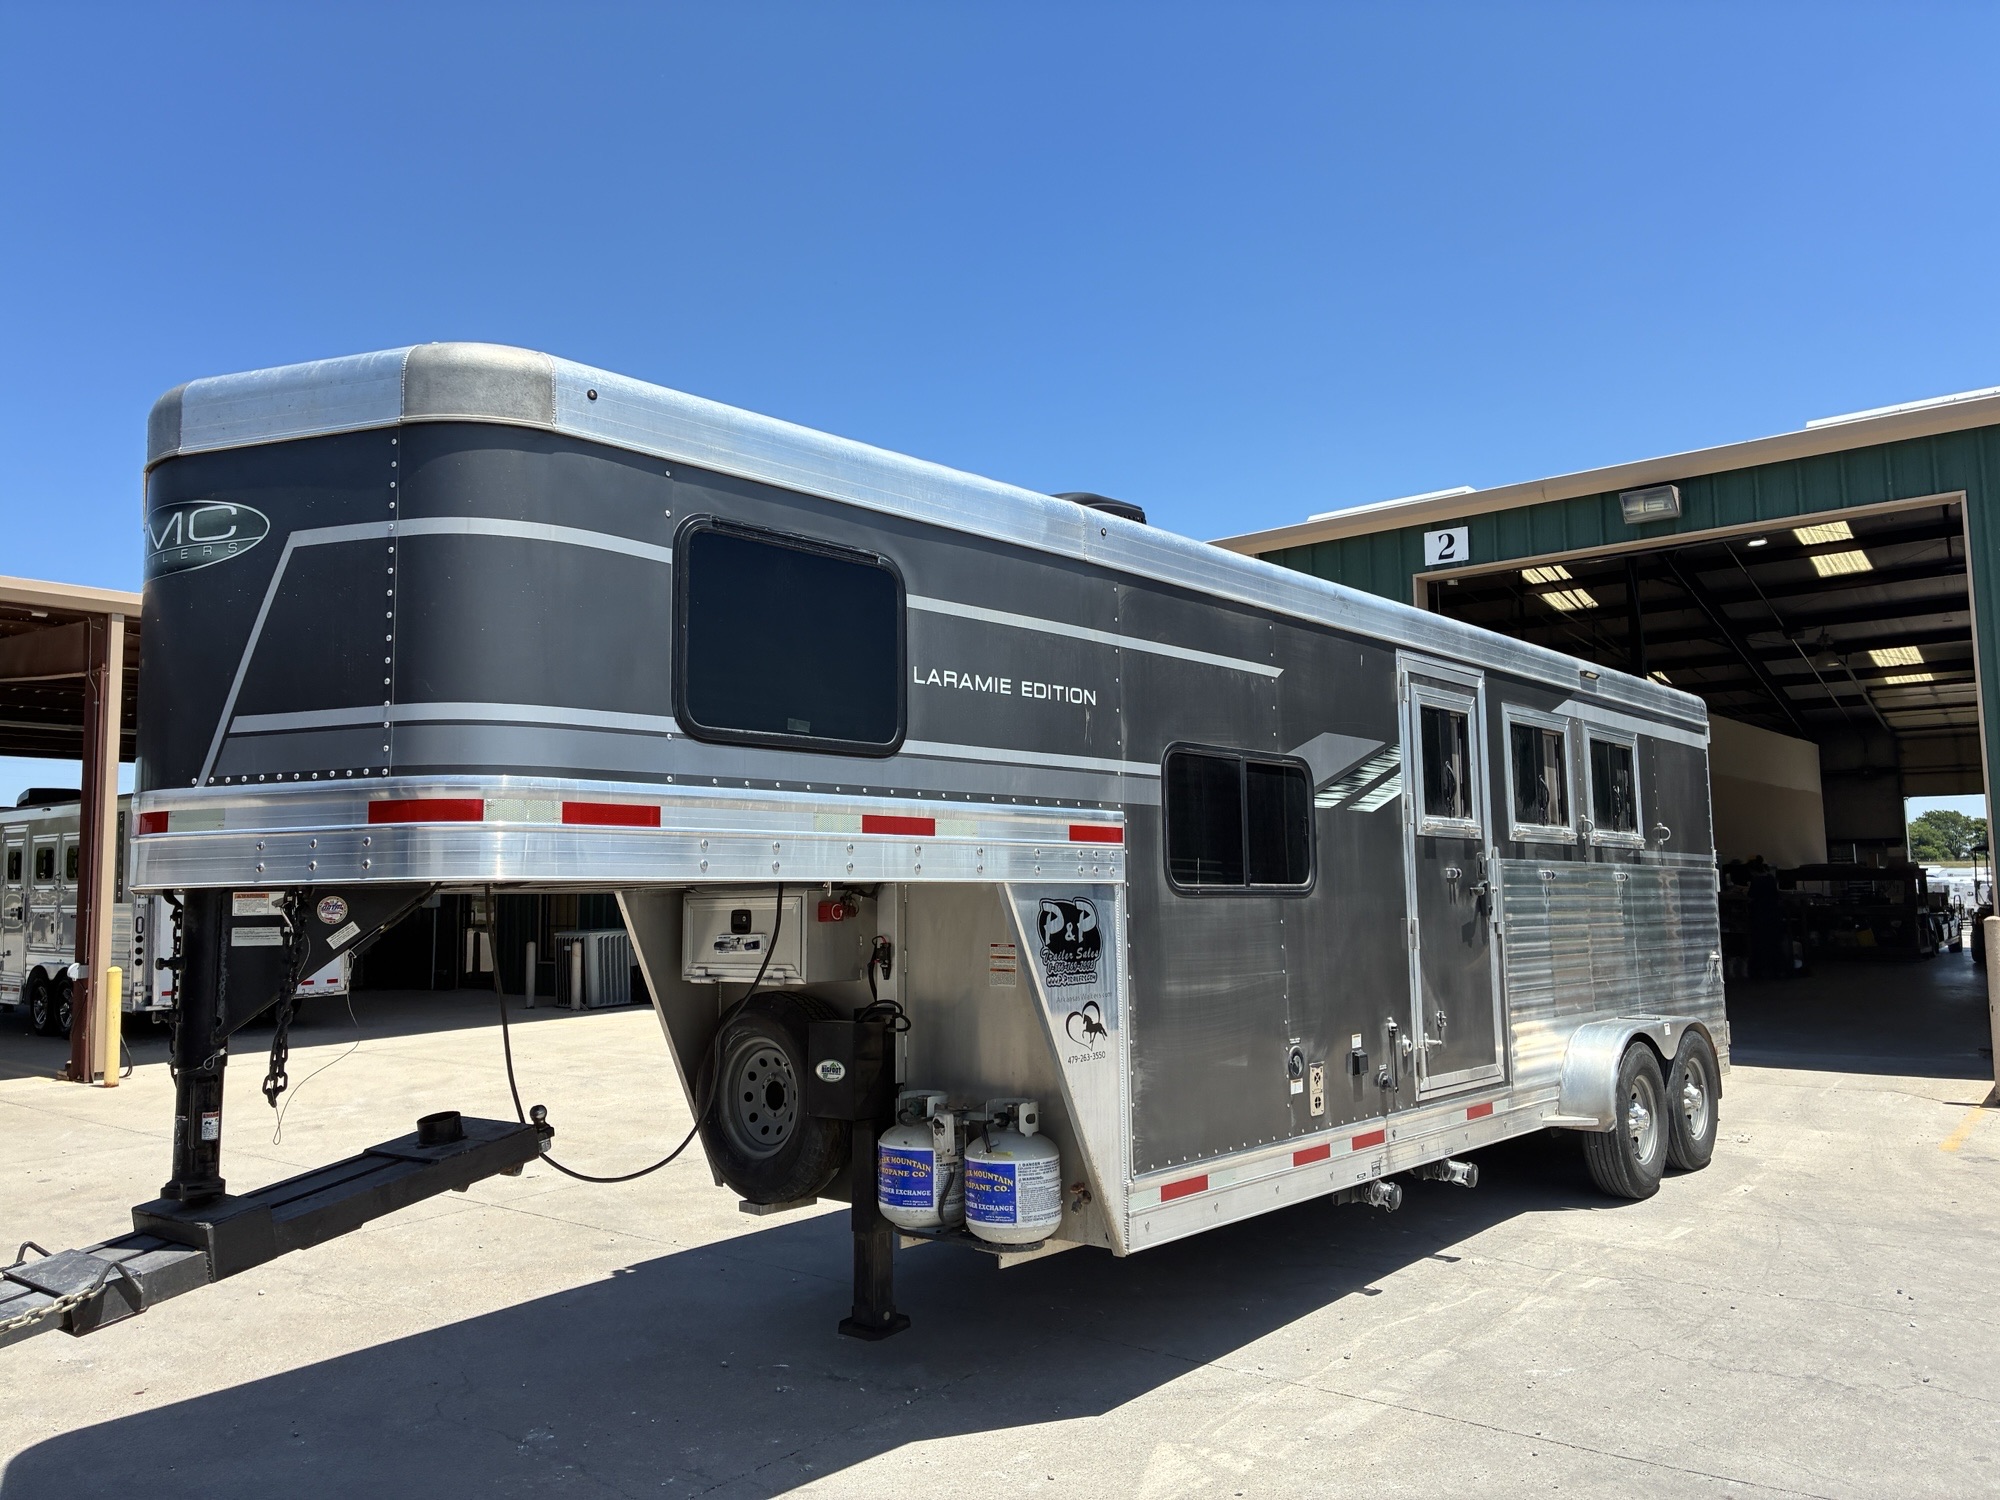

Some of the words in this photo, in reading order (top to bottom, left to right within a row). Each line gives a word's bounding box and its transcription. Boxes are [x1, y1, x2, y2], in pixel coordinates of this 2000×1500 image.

[147, 505, 237, 552] MC
[1438, 533, 1456, 560] 2
[913, 666, 1012, 695] LARAMIE
[1021, 681, 1097, 706] EDITION
[1042, 902, 1065, 946] P
[1065, 922, 1076, 941] &
[1076, 901, 1097, 943] P
[1042, 948, 1074, 966] Trailer
[1076, 947, 1099, 960] Sales
[1068, 1051, 1106, 1064] 479-263-3550
[880, 1168, 910, 1177] ROPANE
[891, 1157, 931, 1172] MOUNTAIN
[973, 1170, 1013, 1186] MOUNTAIN
[978, 1203, 1014, 1212] EXCHANGE
